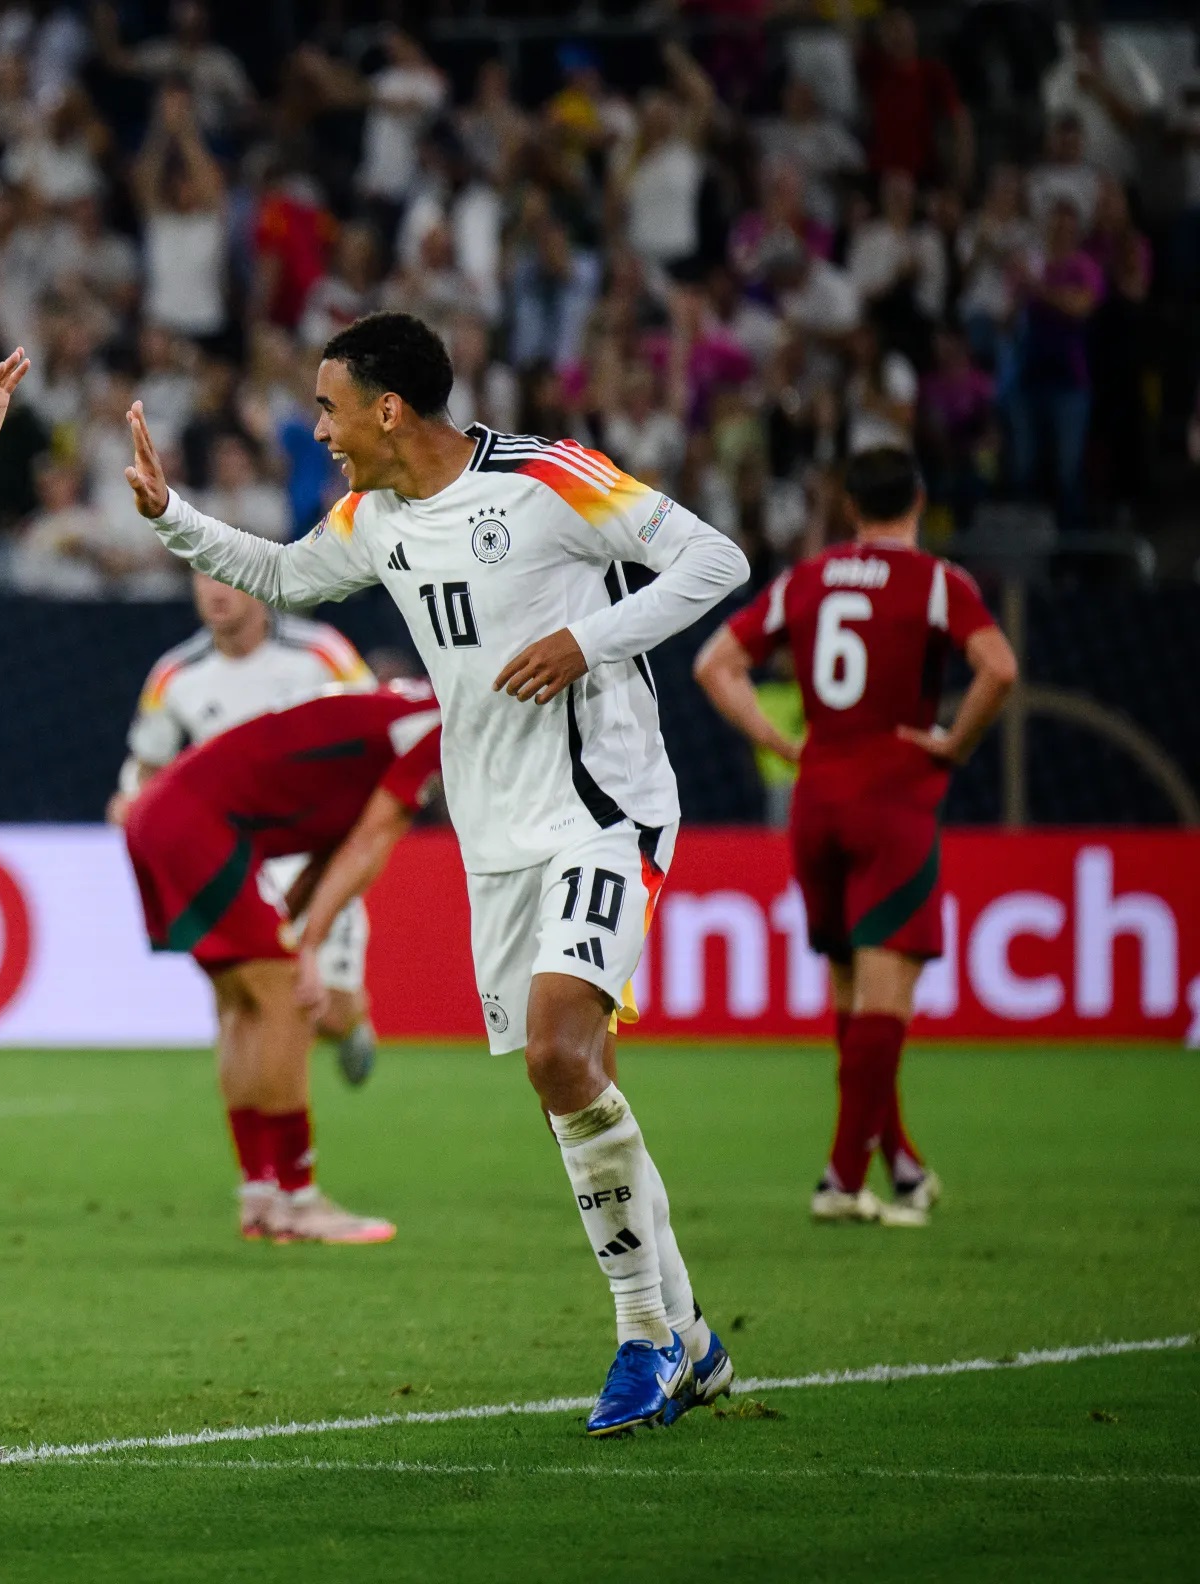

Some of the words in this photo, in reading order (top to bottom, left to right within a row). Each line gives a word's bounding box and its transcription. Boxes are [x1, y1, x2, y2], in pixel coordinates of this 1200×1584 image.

[419, 581, 482, 650] 10
[812, 590, 873, 711] 6
[560, 866, 628, 936] 10
[577, 1185, 632, 1211] DFB
